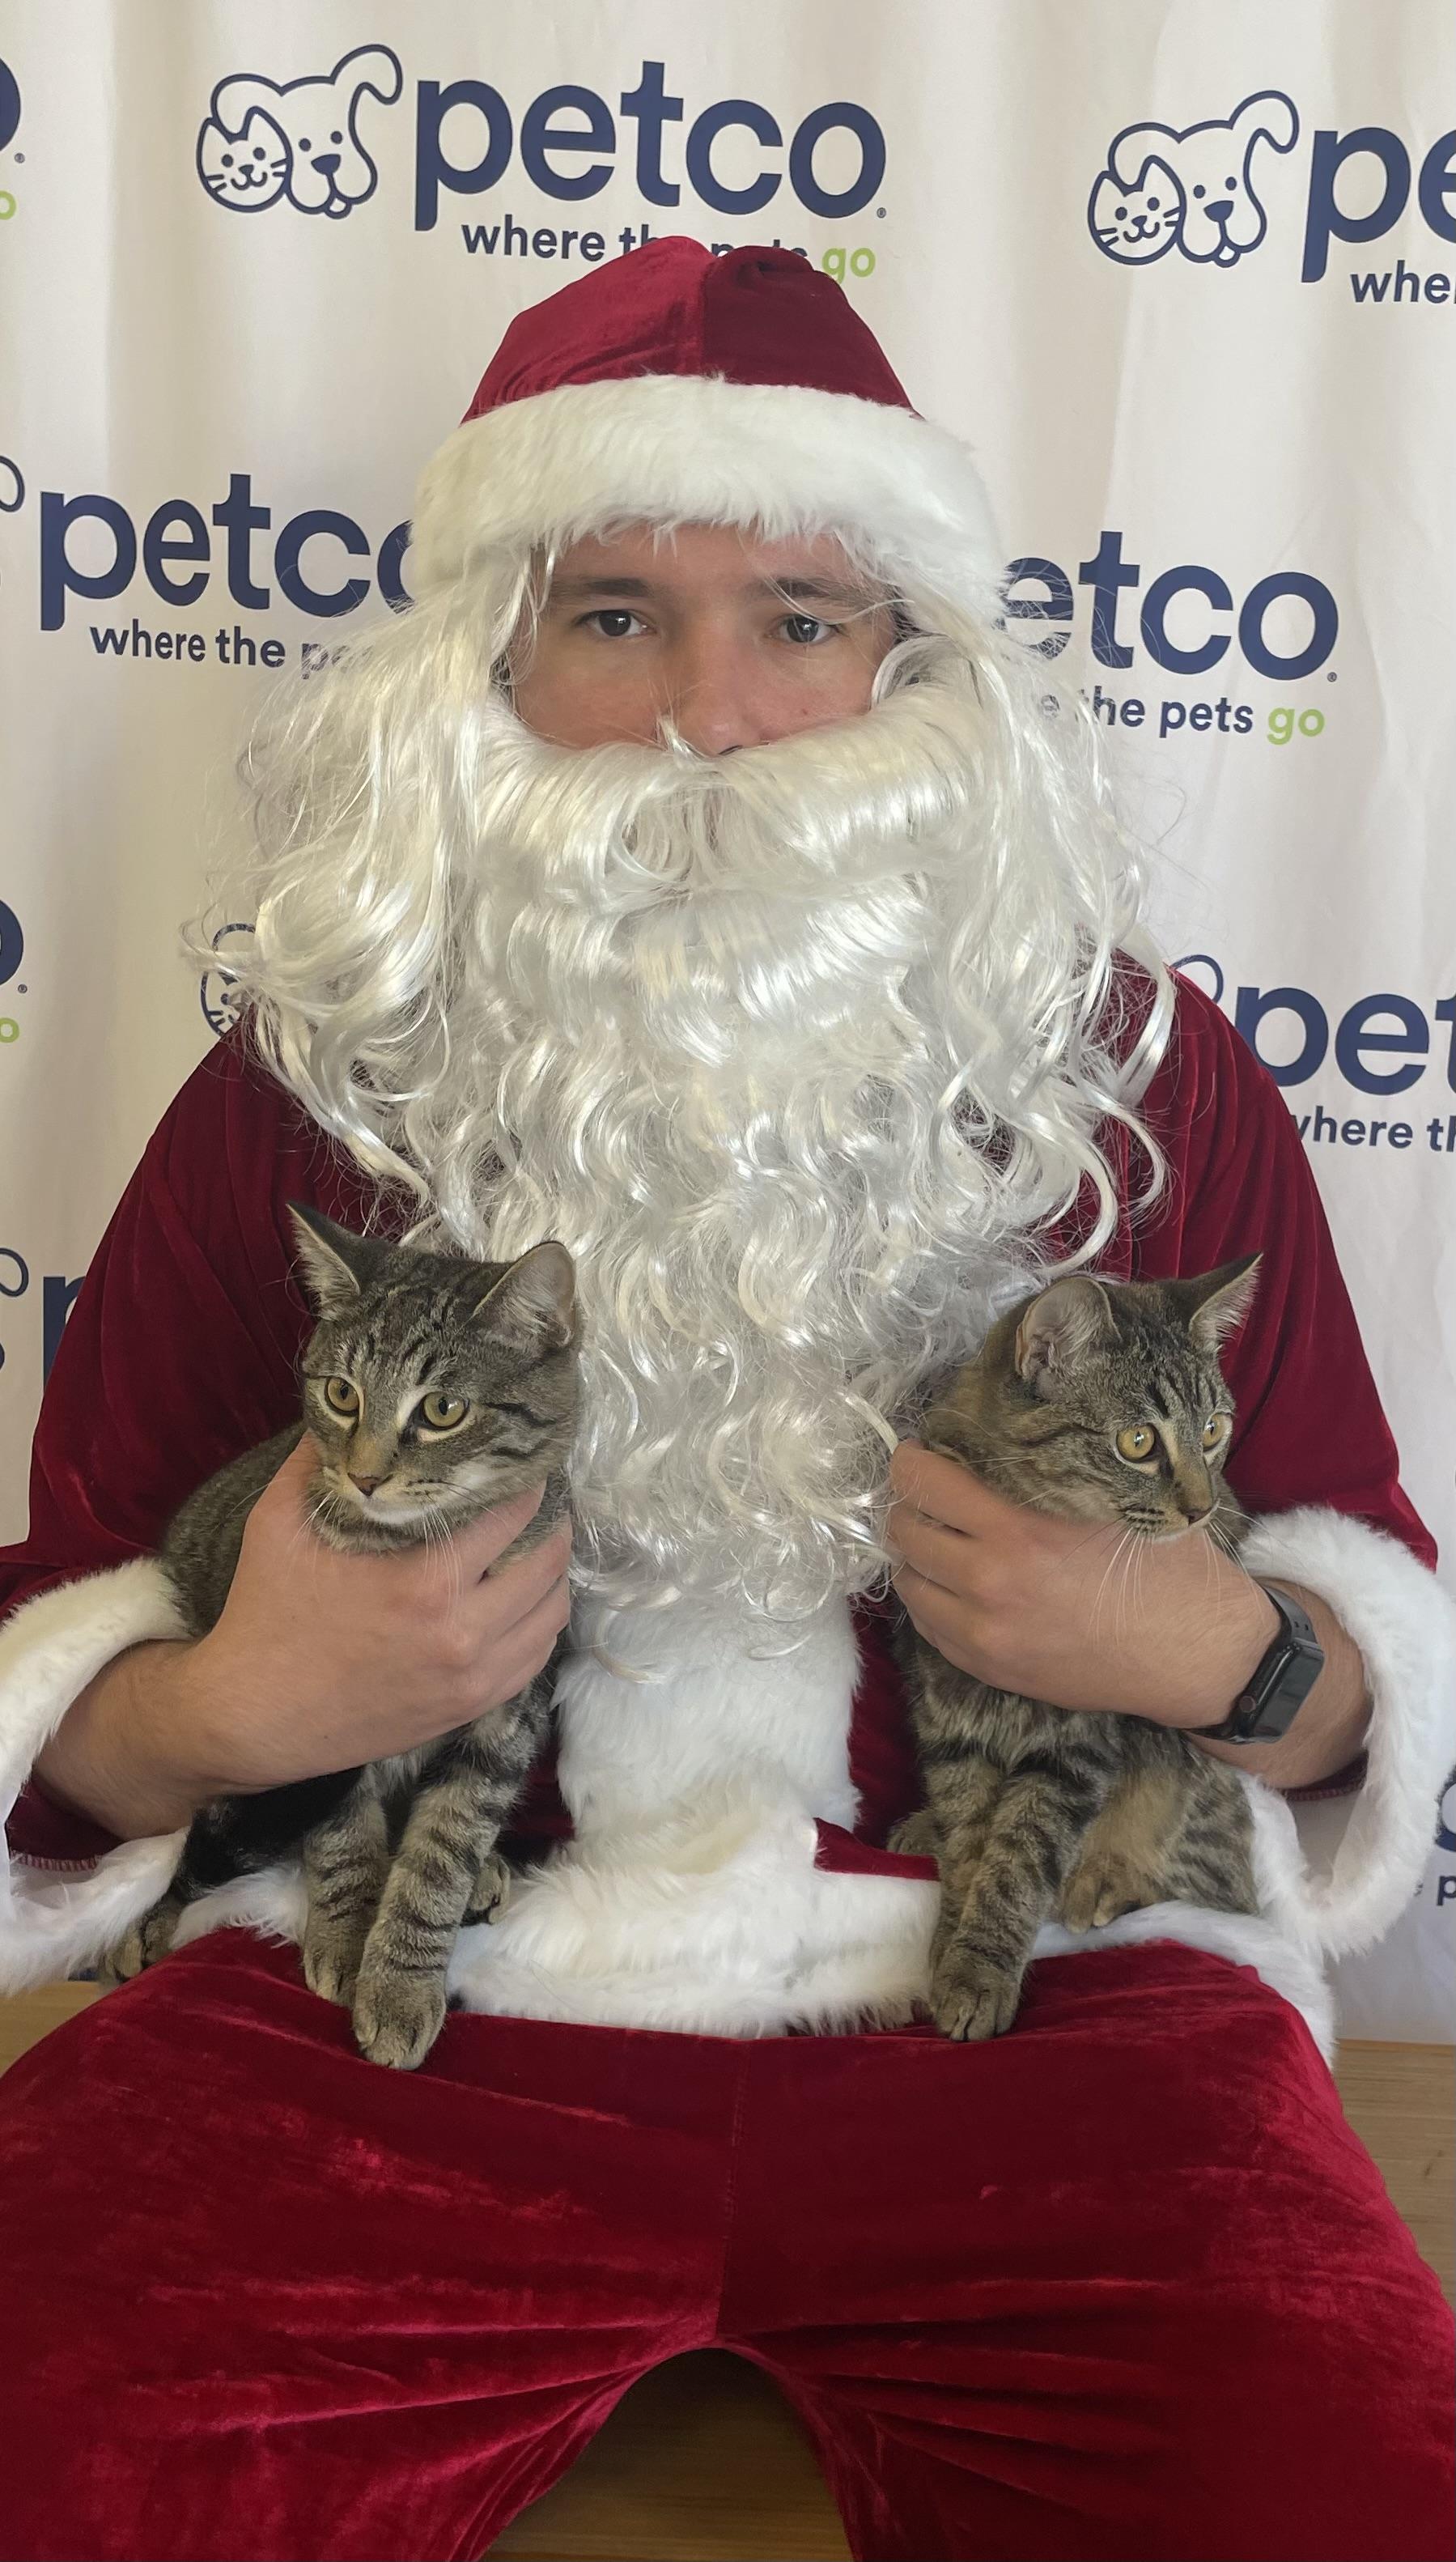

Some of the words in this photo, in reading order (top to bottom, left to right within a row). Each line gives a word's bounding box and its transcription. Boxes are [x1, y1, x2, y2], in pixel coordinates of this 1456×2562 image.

[415, 61, 886, 231] petco
[461, 214, 605, 261] where
[822, 247, 876, 284] go
[1351, 260, 1456, 304] whe
[992, 531, 1338, 680] etco
[90, 618, 206, 662] where
[215, 626, 285, 667] the
[1078, 686, 1145, 727] he
[1159, 697, 1253, 738] pets
[1267, 707, 1325, 746] go
